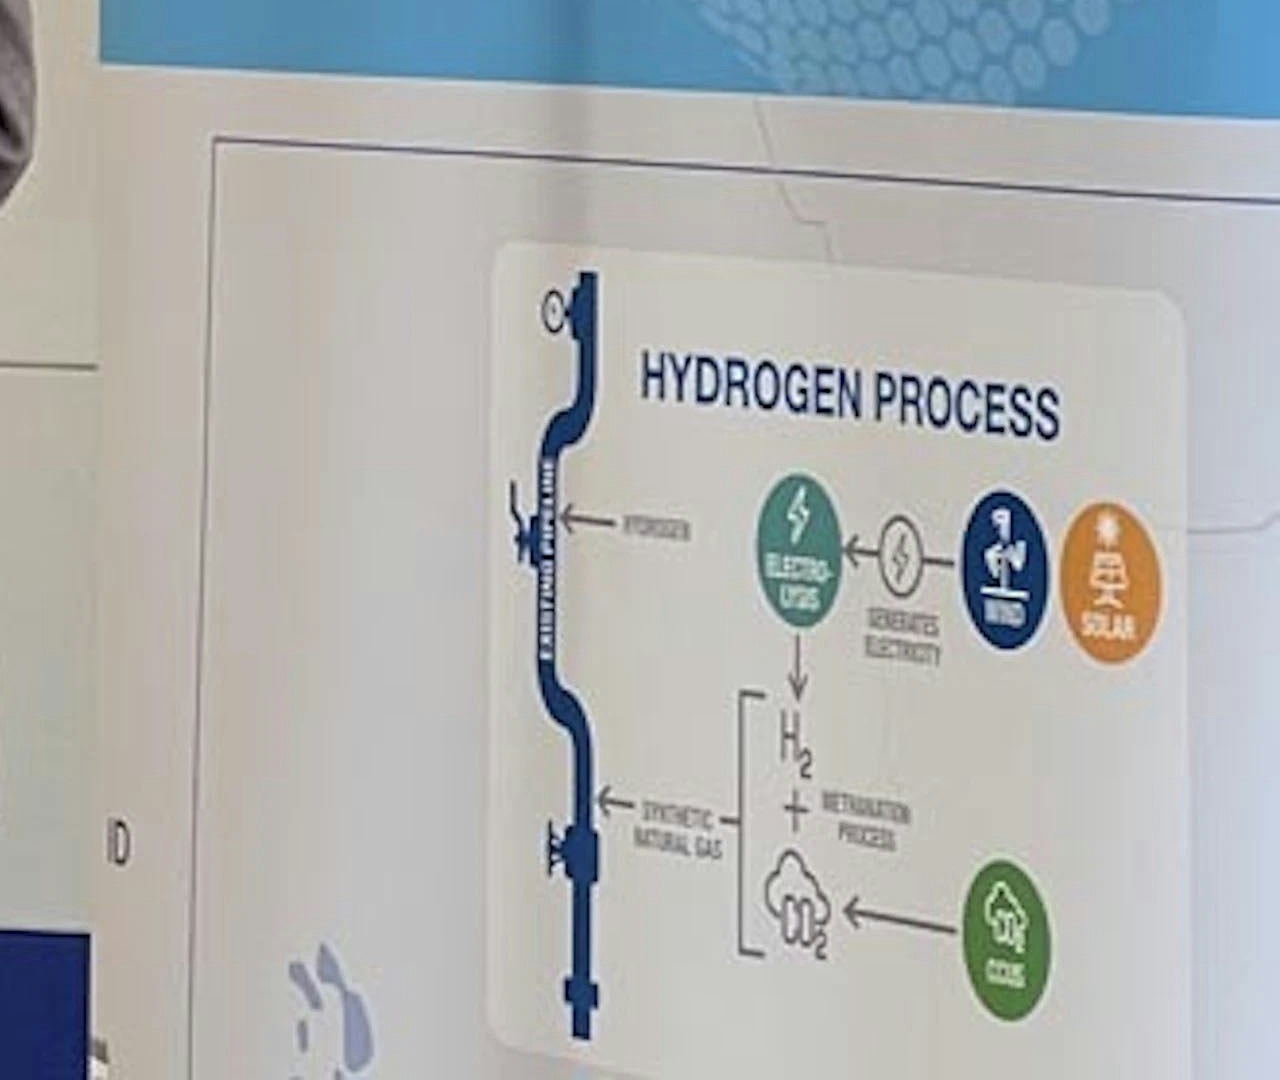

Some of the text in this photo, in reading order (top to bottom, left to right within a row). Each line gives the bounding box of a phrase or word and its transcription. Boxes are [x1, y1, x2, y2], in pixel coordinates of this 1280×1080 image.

[640, 349, 1061, 442] HYDROGEN PROCESS
[540, 461, 556, 661] EXISTING PIPELINE
[1080, 609, 1138, 642] SOLAR
[693, 834, 724, 861] GAS
